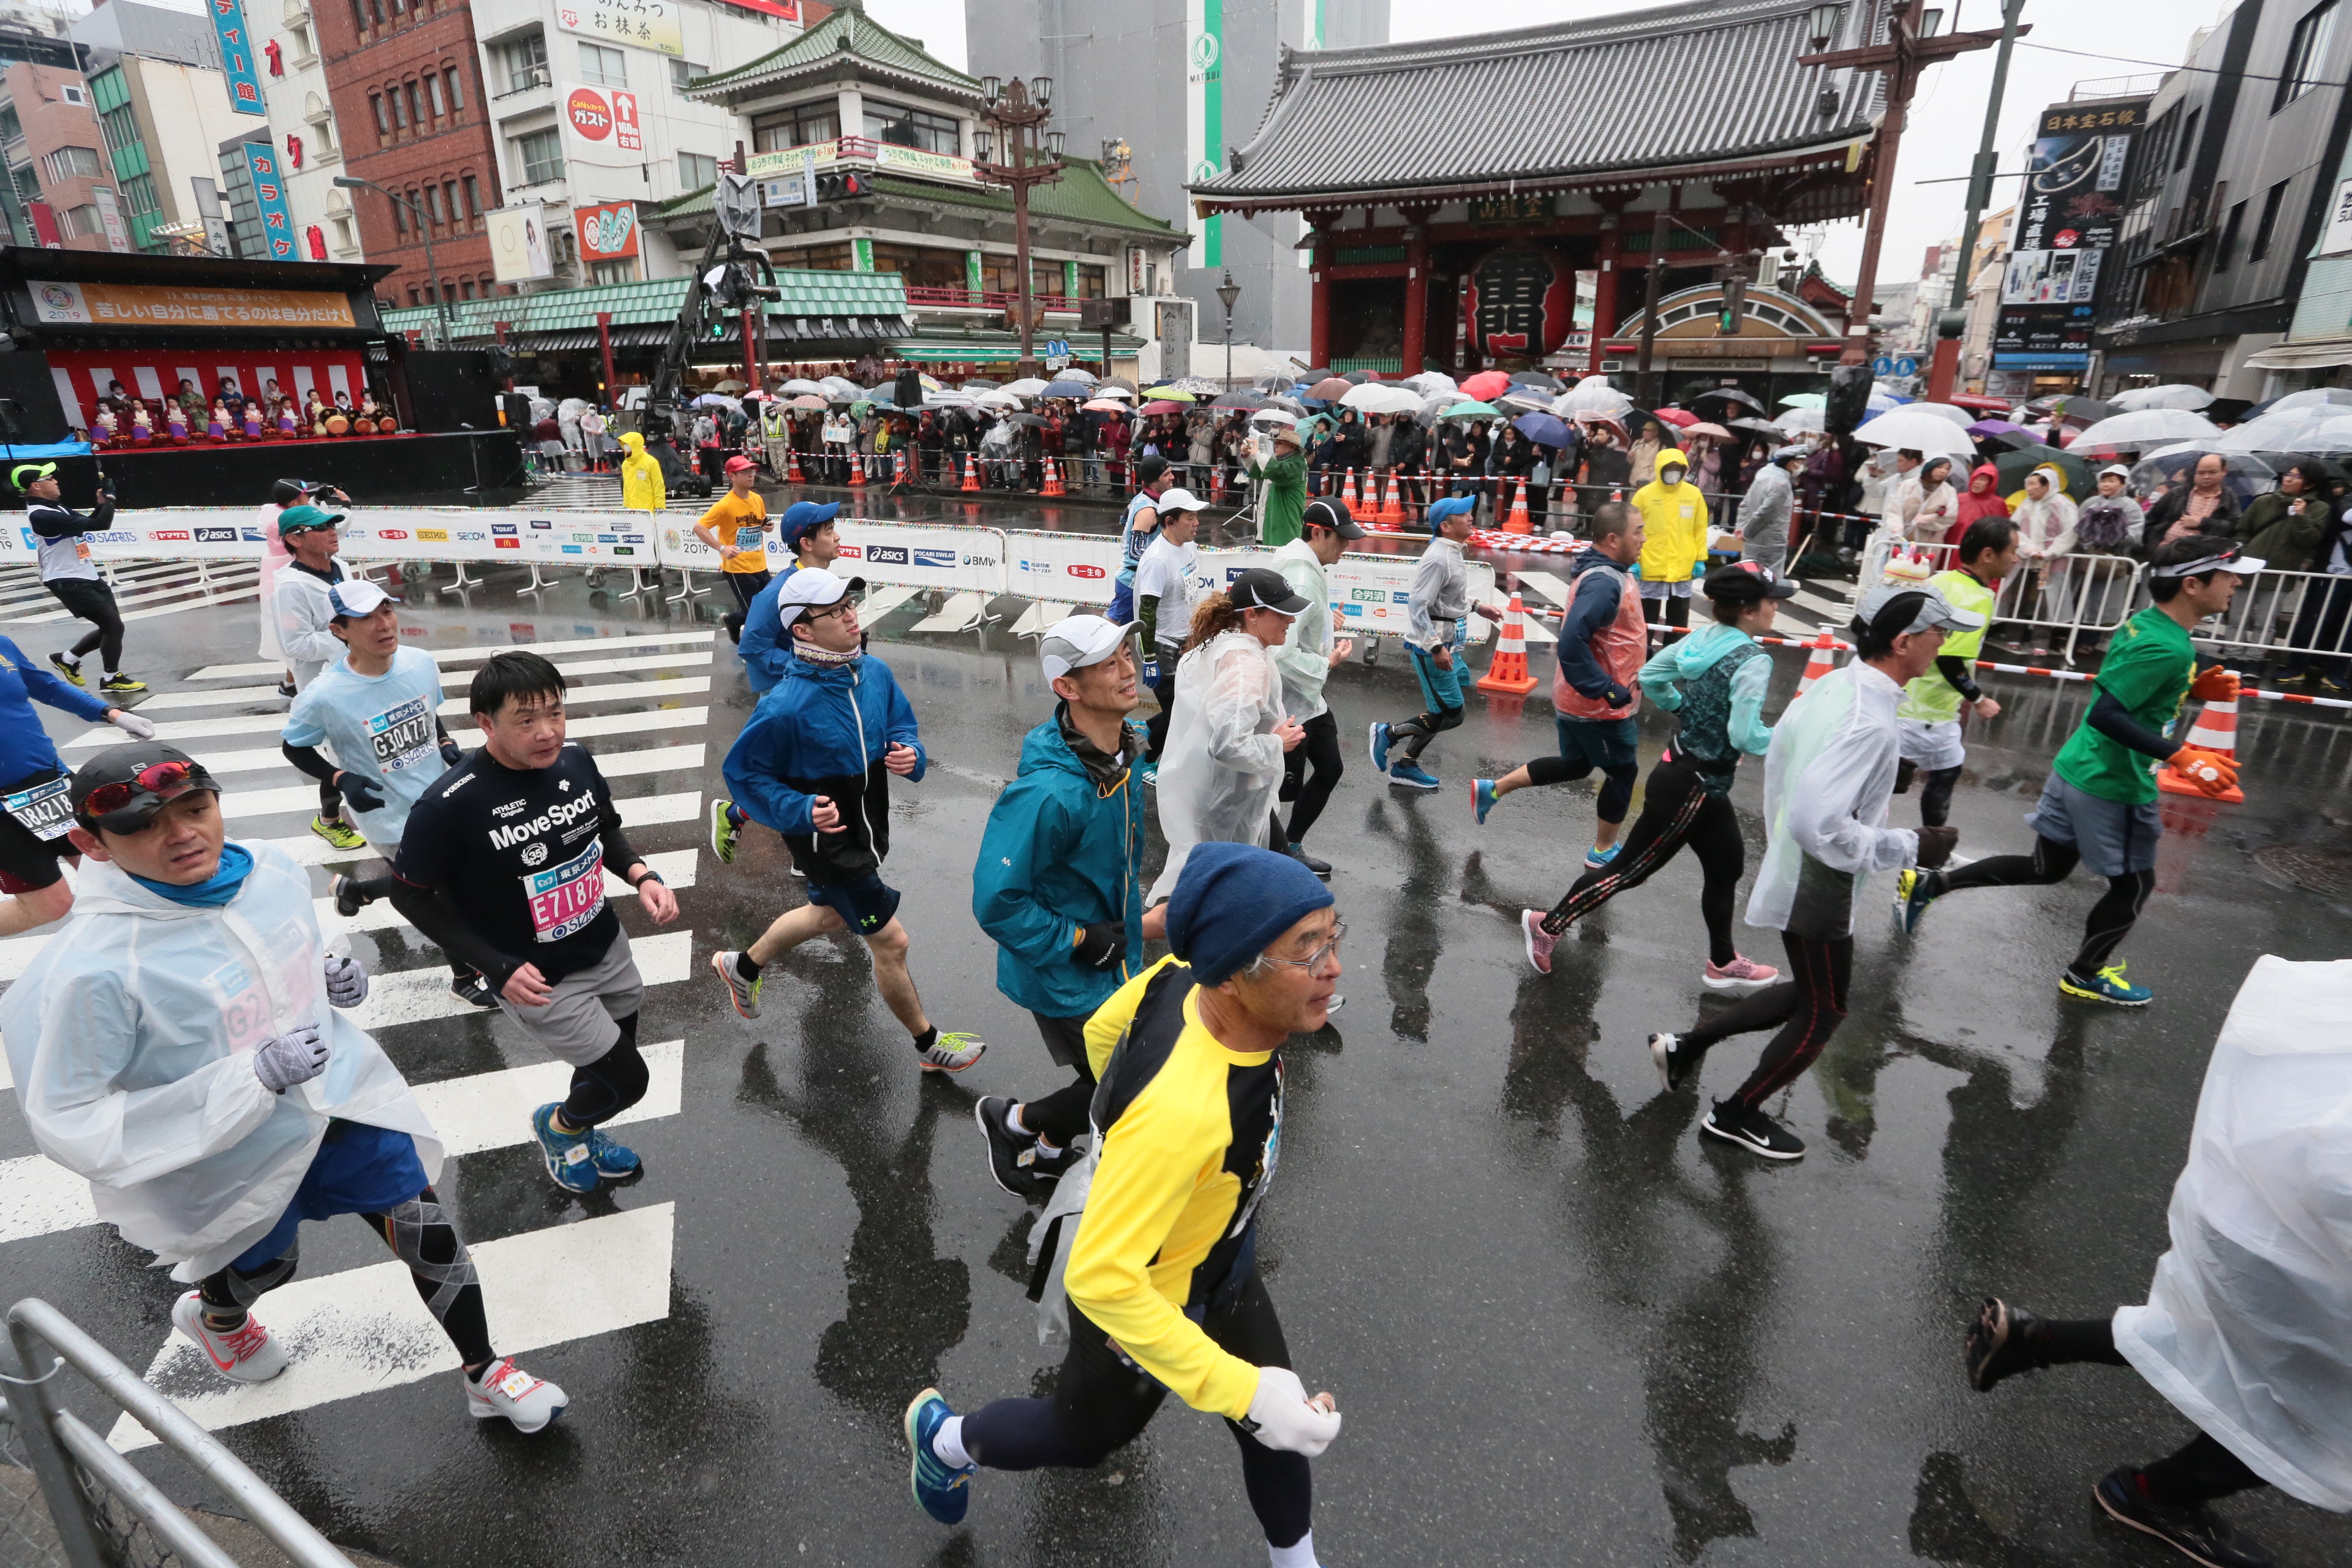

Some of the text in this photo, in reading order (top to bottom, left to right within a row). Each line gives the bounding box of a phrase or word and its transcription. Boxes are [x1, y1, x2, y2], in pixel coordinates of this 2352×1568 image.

[563, 11, 577, 23] 2F
[594, 10, 651, 41] お抹茶
[1189, 70, 1220, 82] MATSUI
[574, 110, 609, 127] ガスト
[2047, 110, 2136, 130] 日本宝石館
[617, 121, 639, 135] 160m
[619, 135, 640, 148] 右側
[816, 145, 835, 157] e-Tax
[254, 157, 292, 255] カラオケ
[2022, 195, 2051, 251] 工場直送
[1472, 249, 1556, 356] 雷門
[48, 311, 81, 320] 2019
[209, 530, 232, 539] asics
[457, 532, 486, 541] SECOM
[737, 534, 760, 544] F26464
[684, 543, 708, 554] 2019
[839, 547, 859, 556] マザキ
[880, 549, 904, 561] asics
[972, 556, 996, 567] BMW
[1071, 567, 1102, 578] 第一生命
[1352, 589, 1385, 601] 全労済
[387, 701, 423, 723] 東京メトロ
[373, 715, 428, 757] G30477
[448, 772, 477, 794] DESCENTE
[31, 782, 63, 800] 東京メトロ
[12, 793, 74, 829] D84218
[492, 798, 527, 816] ATHLETIC
[500, 806, 524, 819] Originals
[529, 848, 543, 860] 35
[560, 847, 599, 880] 東京メトロ
[532, 865, 600, 925] E71875
